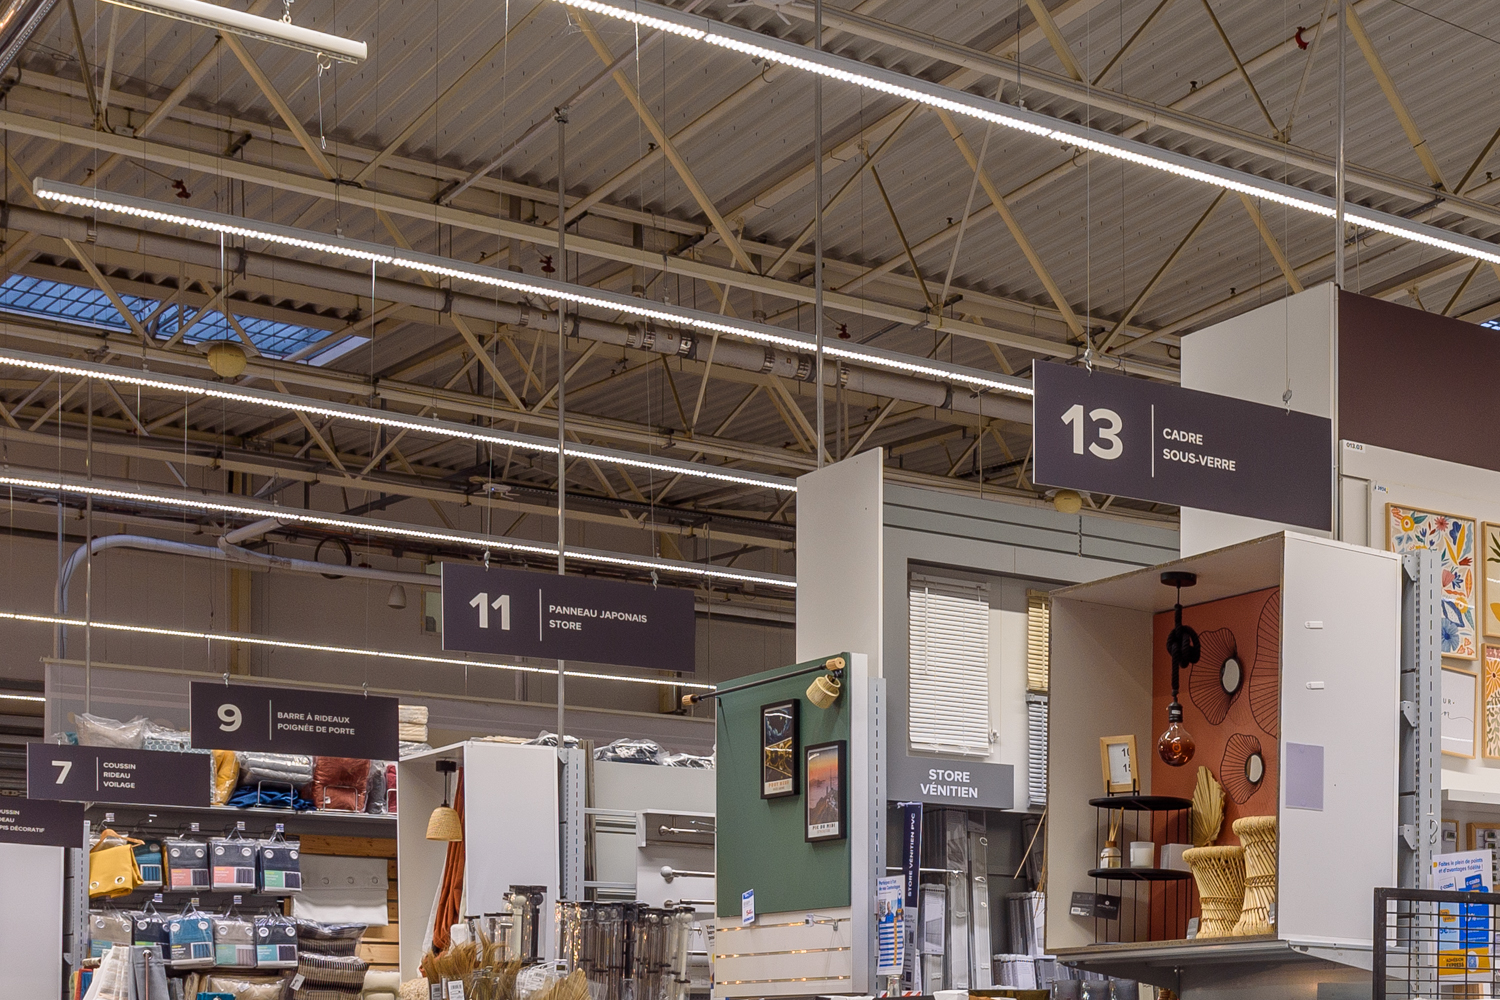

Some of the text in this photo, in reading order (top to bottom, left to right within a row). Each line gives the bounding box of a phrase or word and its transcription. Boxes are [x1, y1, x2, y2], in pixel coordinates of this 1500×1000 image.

[1060, 403, 1124, 460] 13
[1162, 428, 1204, 446] CADRE
[1162, 449, 1236, 472] SOUS-VERRE
[469, 592, 511, 631] 11
[549, 605, 648, 623] PANNEAU JAPONAIS
[549, 619, 582, 631] STORE
[217, 703, 243, 732] 9
[277, 711, 350, 724] BARRE À RIDEAUX
[277, 722, 355, 735] POIGNÉE DE PORTE
[51, 760, 72, 785] 7
[103, 761, 136, 771] COUSSIN
[103, 771, 131, 779] RIDEAU
[928, 768, 970, 784] STORE
[103, 780, 136, 789] VOILAGE
[920, 780, 978, 799] VÉNITIEN
[10, 825, 45, 833] DÉCORATIF
